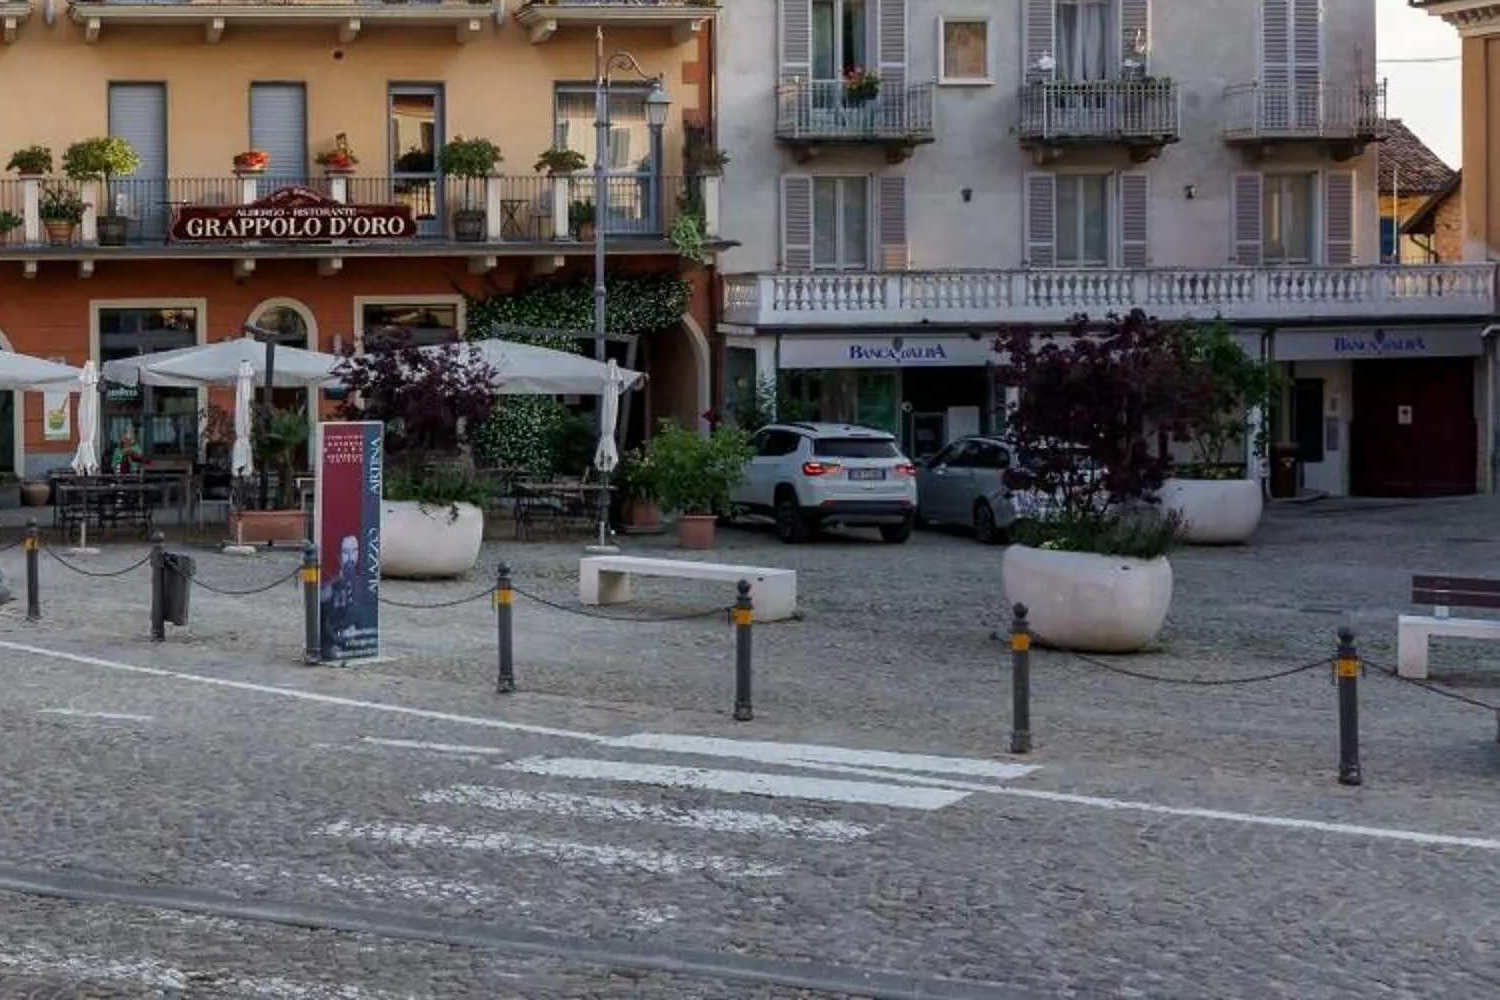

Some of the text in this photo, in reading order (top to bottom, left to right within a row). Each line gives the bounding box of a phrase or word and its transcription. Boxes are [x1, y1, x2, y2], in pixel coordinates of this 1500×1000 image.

[235, 208, 285, 217] ALBERGO
[293, 207, 357, 217] RISTORANTE
[186, 215, 405, 237] GRAPPOLO D'ORO
[849, 344, 896, 359] BANCA
